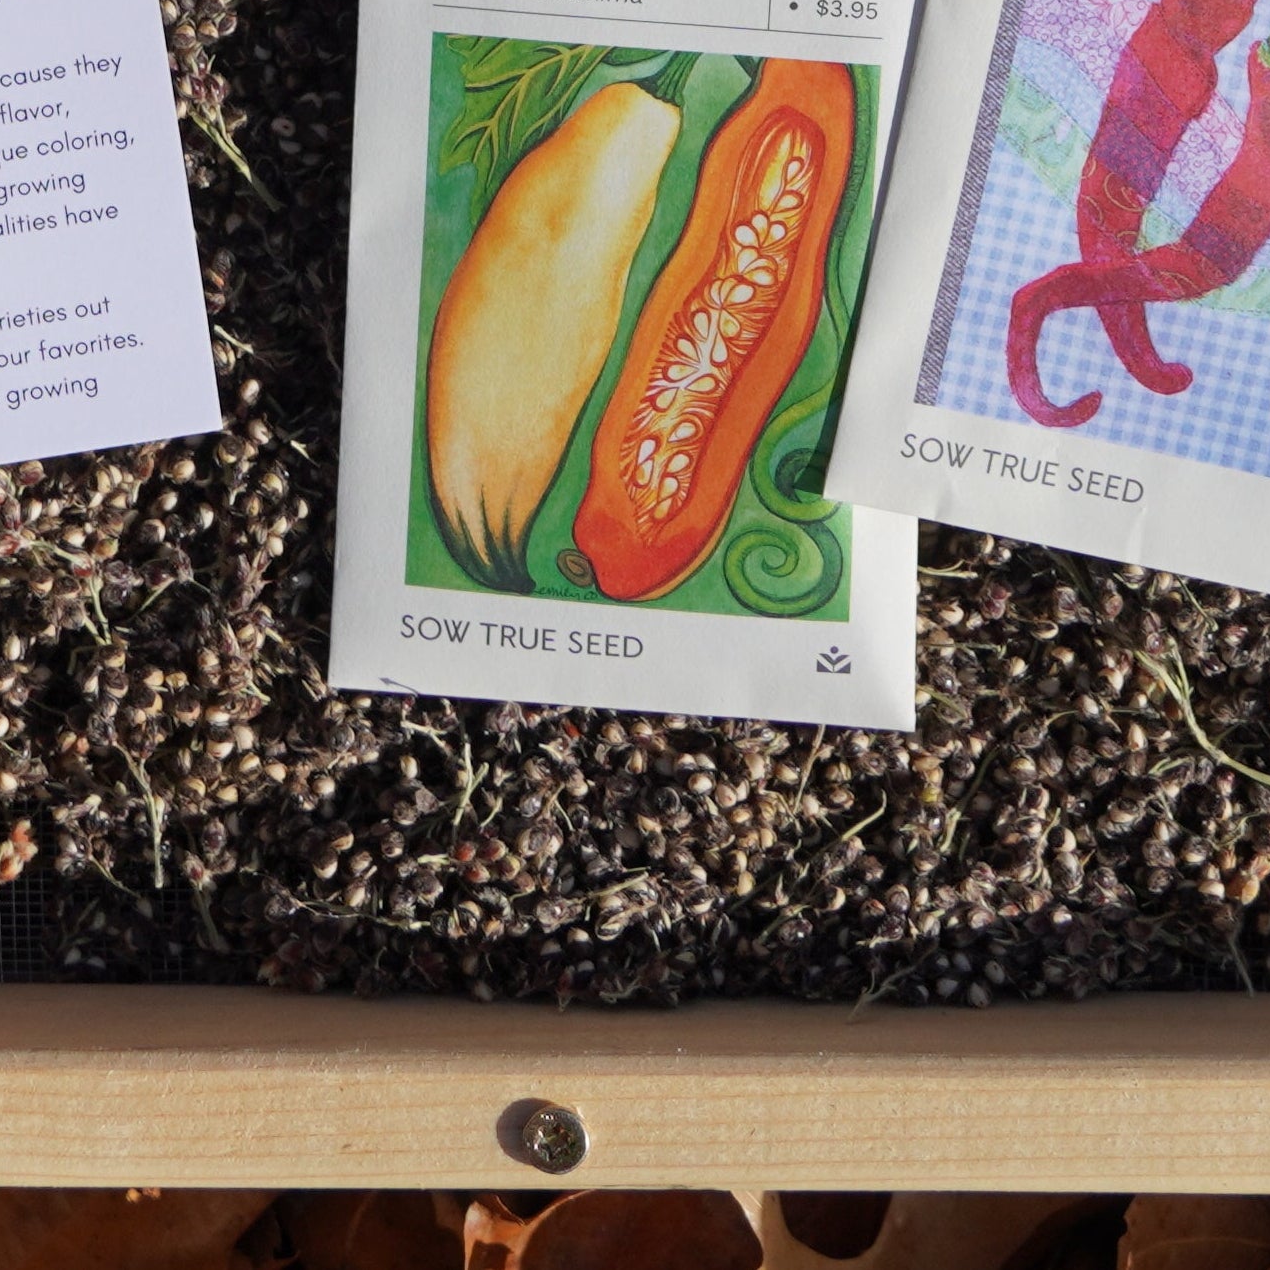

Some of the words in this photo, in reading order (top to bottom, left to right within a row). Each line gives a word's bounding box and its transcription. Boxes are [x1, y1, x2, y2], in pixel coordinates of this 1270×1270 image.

[73, 53, 122, 77] they
[74, 296, 111, 318] out
[900, 433, 975, 469] SOW
[982, 448, 1060, 487] TRUE
[1067, 466, 1145, 504] SEED
[400, 614, 471, 644] SOW
[479, 622, 557, 652] TRUE
[567, 630, 644, 658] SEED
